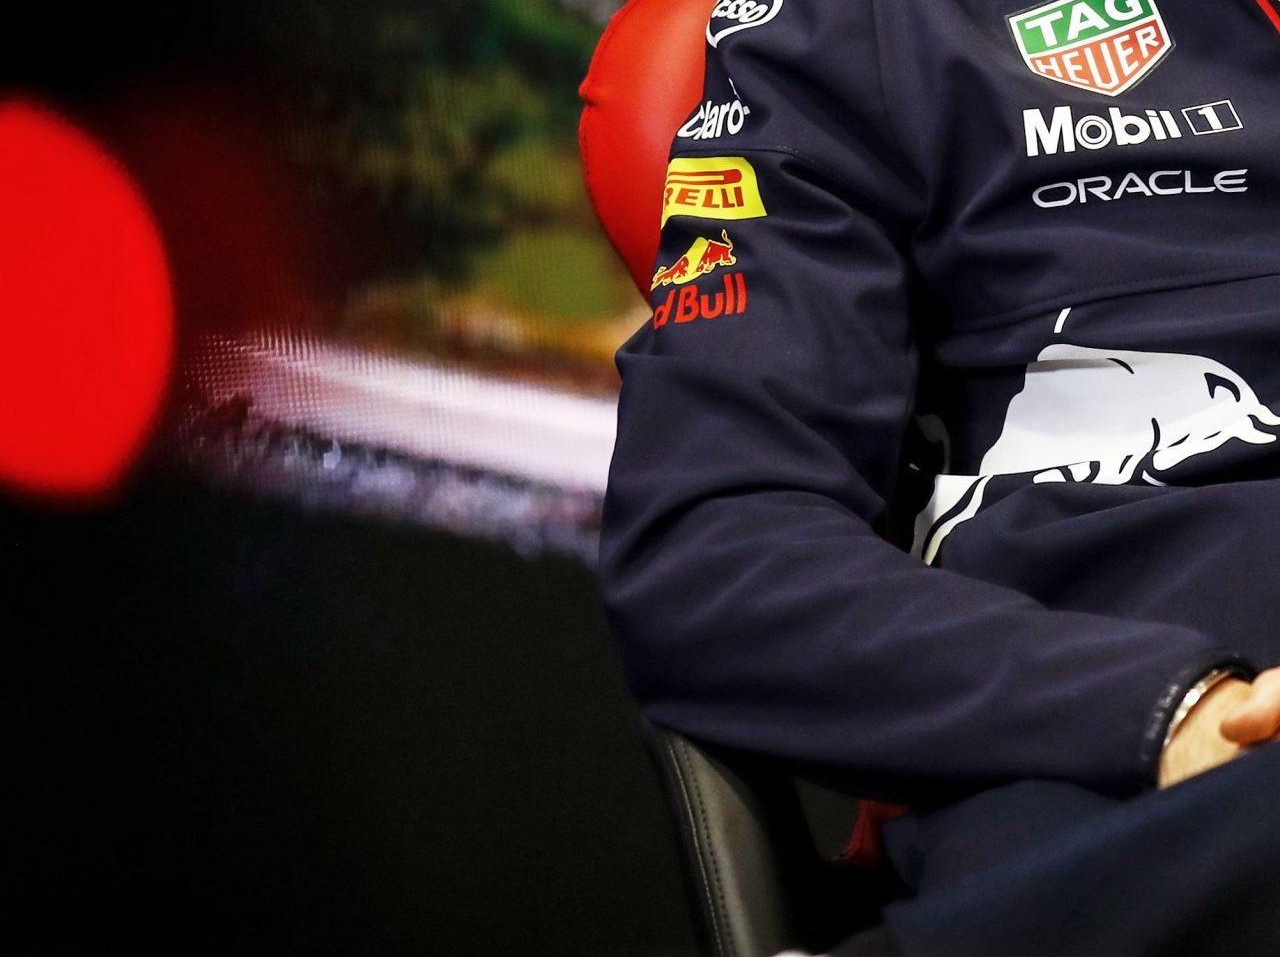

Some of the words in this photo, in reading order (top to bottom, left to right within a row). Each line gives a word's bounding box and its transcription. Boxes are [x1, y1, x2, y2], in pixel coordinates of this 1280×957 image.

[1037, 25, 1160, 89] HEUER
[677, 100, 745, 140] Claro
[1022, 106, 1182, 157] Mobil
[1032, 169, 1248, 208] ORACLE
